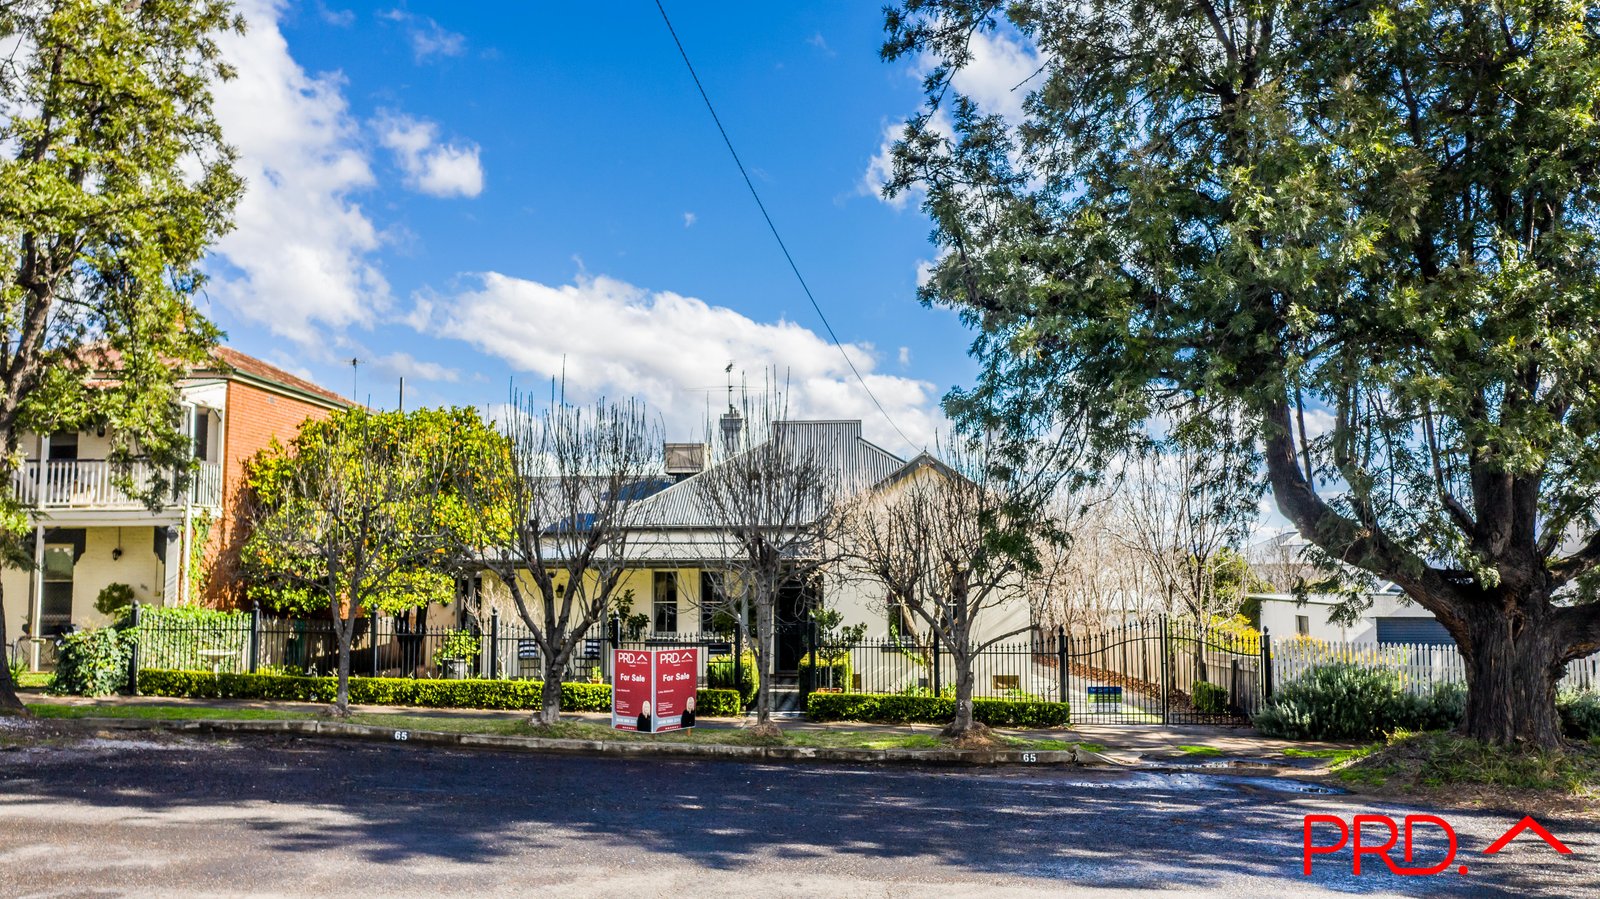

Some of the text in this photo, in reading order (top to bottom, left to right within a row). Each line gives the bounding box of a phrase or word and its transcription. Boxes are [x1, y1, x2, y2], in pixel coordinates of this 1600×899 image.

[620, 673, 646, 683] For Sale
[662, 672, 690, 682] For Sale
[394, 731, 408, 741] 65
[1023, 753, 1037, 763] 65
